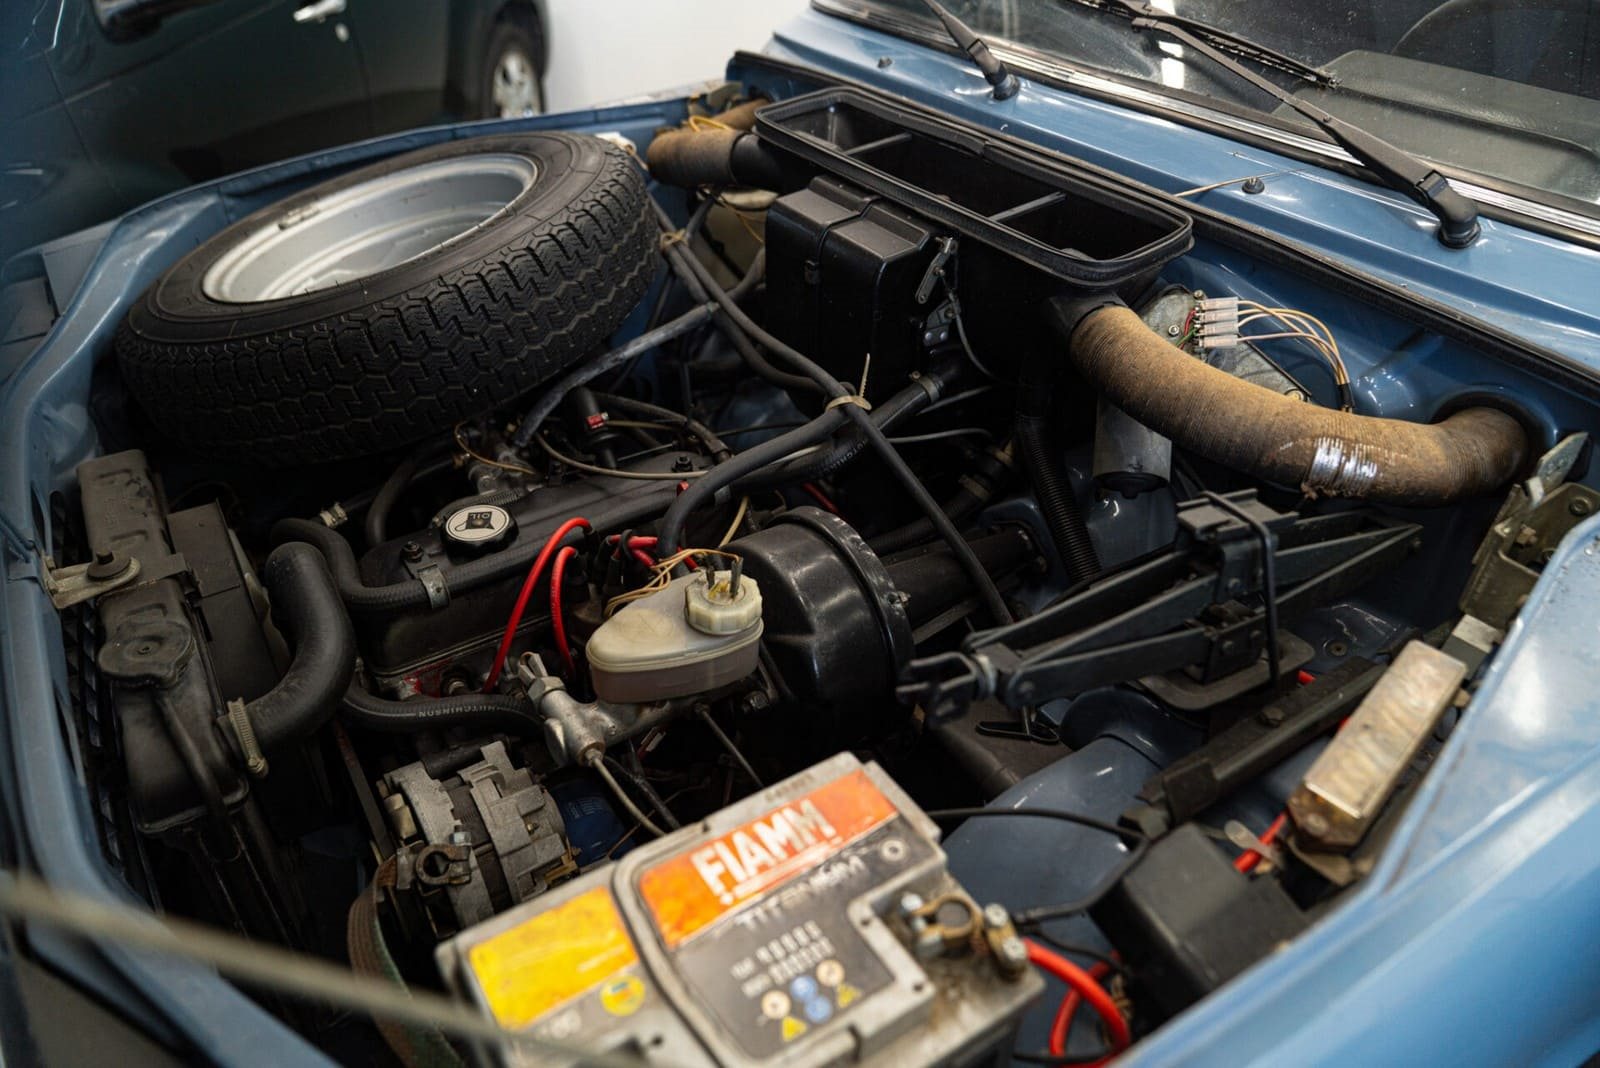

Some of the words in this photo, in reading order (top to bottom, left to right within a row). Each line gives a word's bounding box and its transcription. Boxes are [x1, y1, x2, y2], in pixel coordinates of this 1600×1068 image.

[469, 512, 491, 520] OIL
[418, 704, 497, 718] HUTCHINSON
[691, 799, 836, 896] FIAMM
